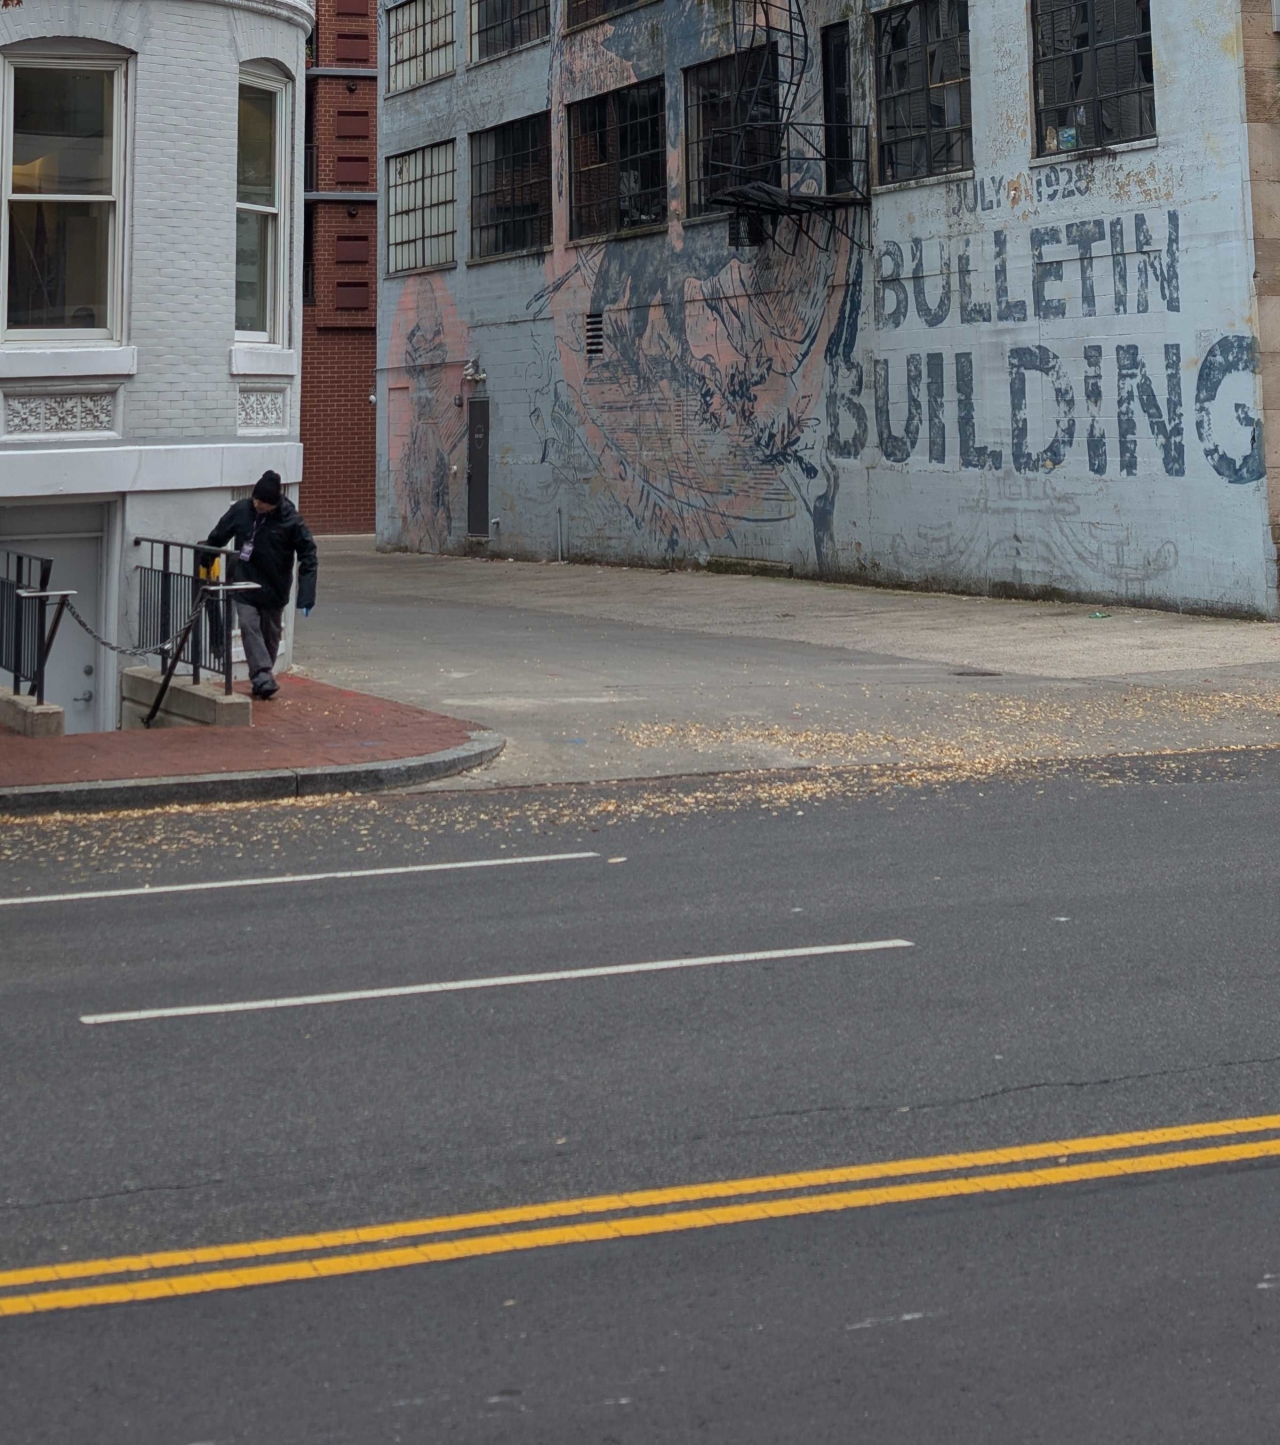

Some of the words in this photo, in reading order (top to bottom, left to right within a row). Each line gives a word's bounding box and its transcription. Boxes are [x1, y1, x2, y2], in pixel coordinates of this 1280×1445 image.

[951, 174, 1004, 217] JULY
[873, 210, 1181, 330] BULLETIN
[824, 334, 1267, 484] BUILDING
